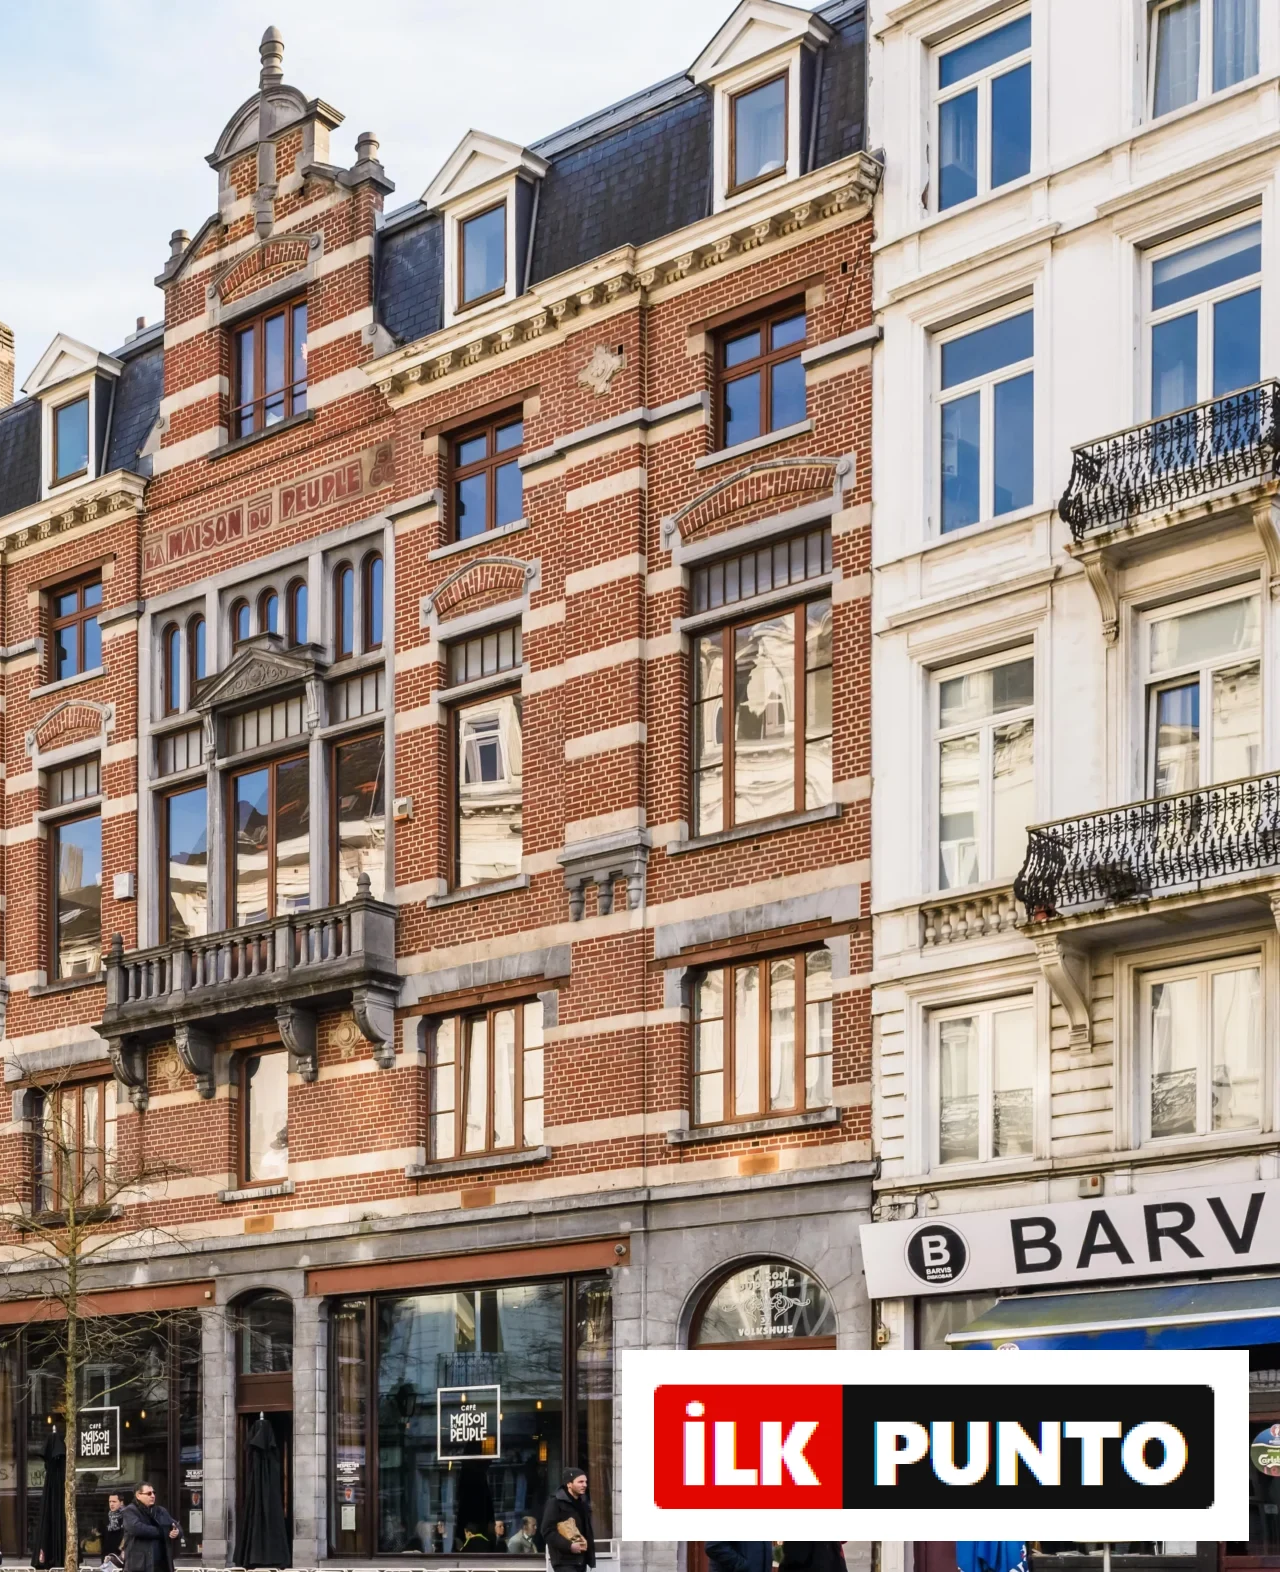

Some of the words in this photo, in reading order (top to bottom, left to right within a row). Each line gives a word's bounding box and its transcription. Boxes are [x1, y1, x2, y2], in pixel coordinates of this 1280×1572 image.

[145, 543, 165, 570] LA
[168, 507, 243, 560] MAISON
[249, 509, 269, 530] DU
[281, 464, 361, 520] PEUPLE
[1010, 1191, 1266, 1274] BARV
[921, 1234, 951, 1267] B
[926, 1266, 952, 1275] BARVIS
[738, 1325, 794, 1337] VOLKSHUIS
[451, 1412, 487, 1428] MAISON
[81, 1430, 109, 1443] MAISON
[451, 1427, 487, 1442] PEUPLE
[81, 1443, 109, 1456] PEUPLE
